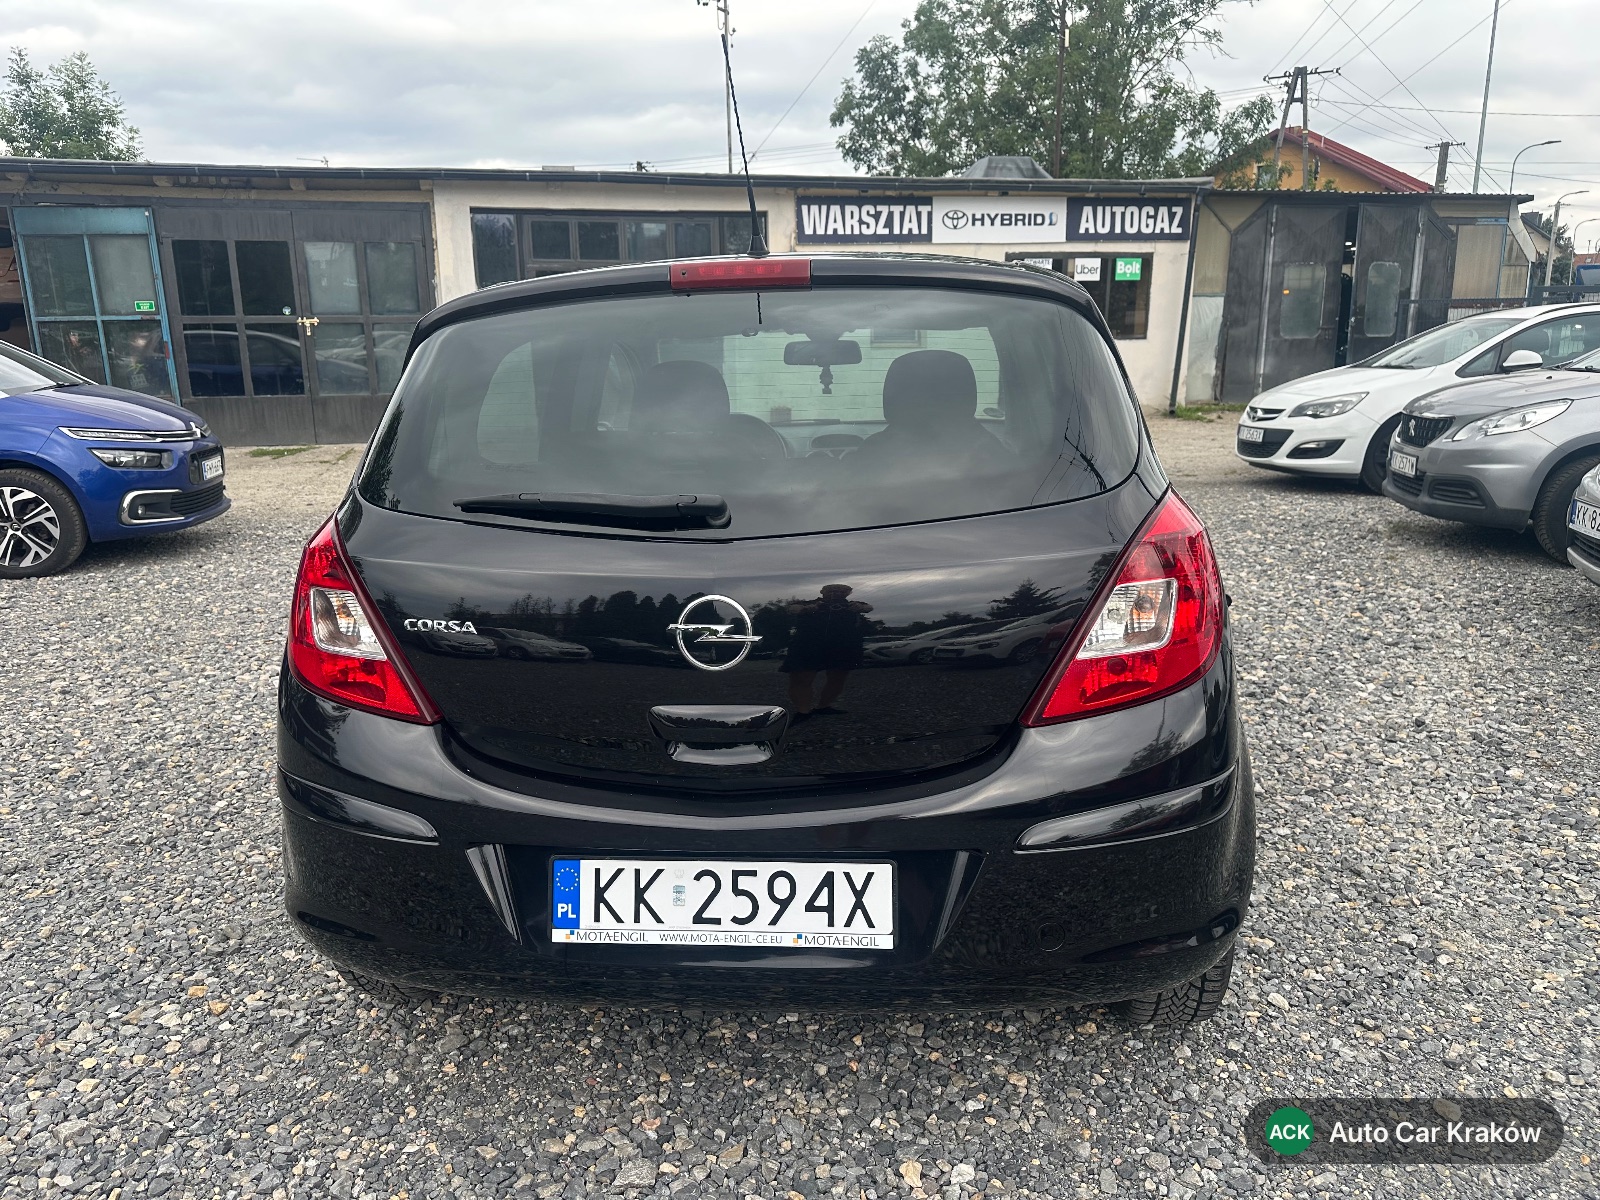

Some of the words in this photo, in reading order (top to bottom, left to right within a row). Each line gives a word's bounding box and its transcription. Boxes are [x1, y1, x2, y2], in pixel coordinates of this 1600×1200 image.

[801, 204, 932, 236] WARSZTAT
[971, 212, 1046, 227] HYBRID
[1078, 205, 1183, 235] AUTOGAZ
[1075, 264, 1099, 275] Uber
[1117, 261, 1140, 275] Bolt
[1577, 505, 1589, 528] KK
[403, 617, 479, 636] CORSA
[594, 867, 666, 924] KK
[692, 869, 876, 929] 2594X
[557, 903, 577, 919] PL
[659, 933, 783, 945] WWW.MOTA-ENGIL-CE.EU
